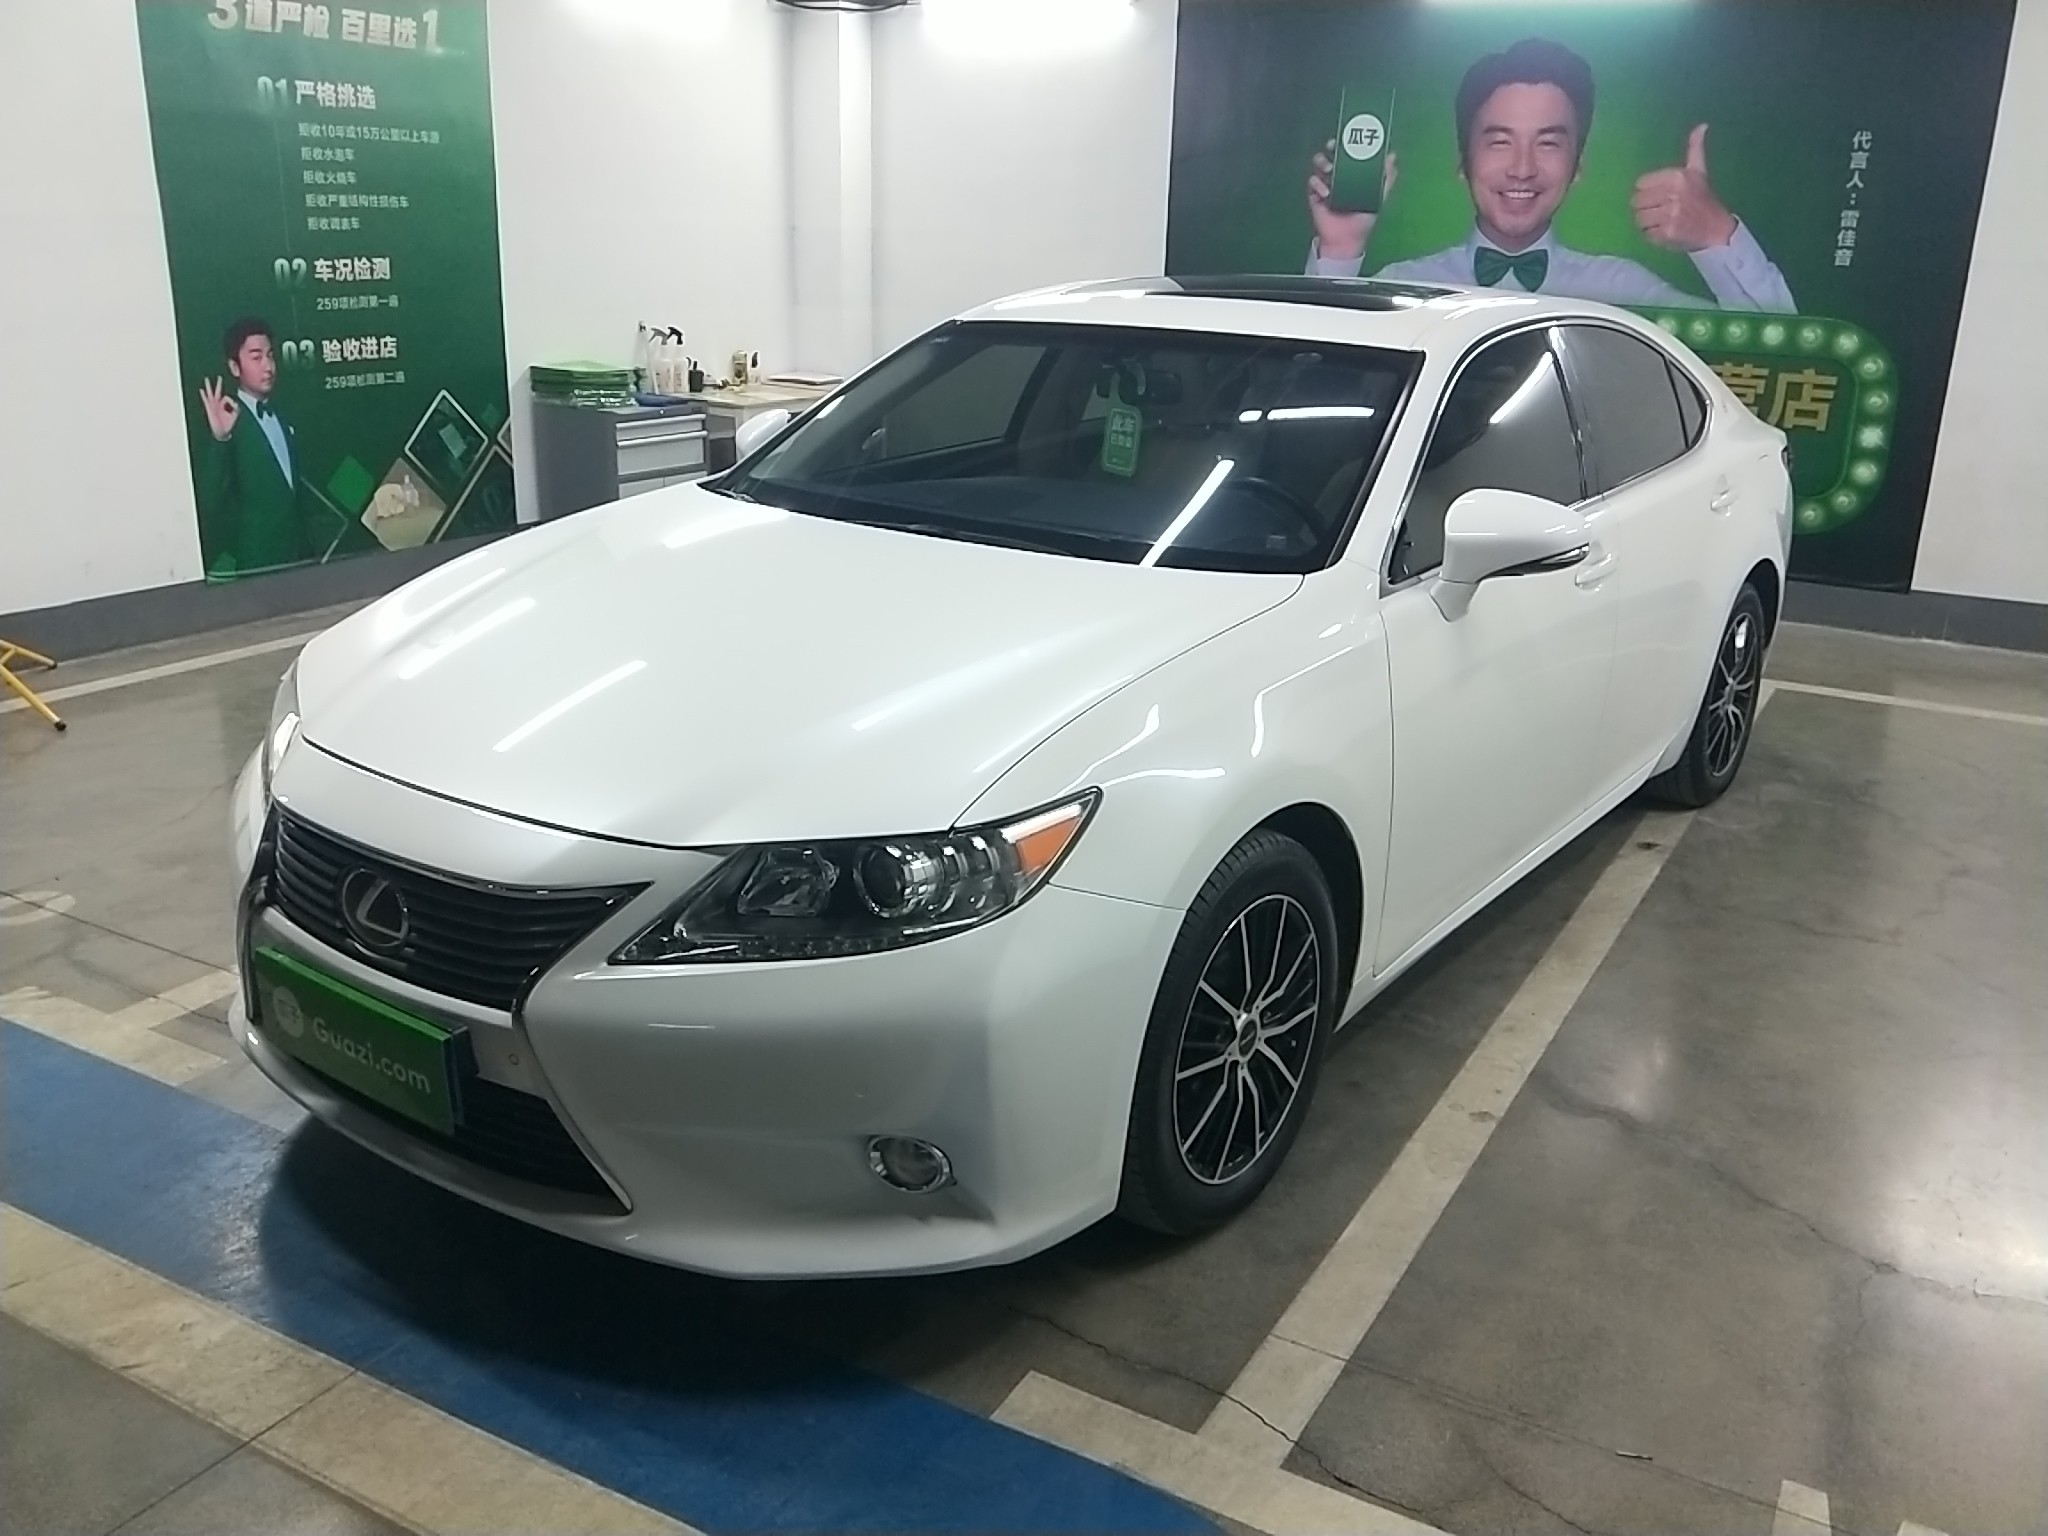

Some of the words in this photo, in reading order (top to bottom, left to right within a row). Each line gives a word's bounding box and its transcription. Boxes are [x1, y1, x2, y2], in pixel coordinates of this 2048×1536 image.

[257, 76, 289, 110] 01
[295, 79, 377, 110] 严格挑选
[1347, 127, 1380, 146] 瓜子
[301, 147, 355, 161] 拒收水泡车
[303, 170, 357, 185] 拒收火烧车
[273, 257, 308, 288] 02
[313, 256, 391, 282] 车况检测
[282, 339, 315, 368] 03
[321, 335, 398, 363] 验收进店
[312, 1016, 432, 1094] Guazi.com
